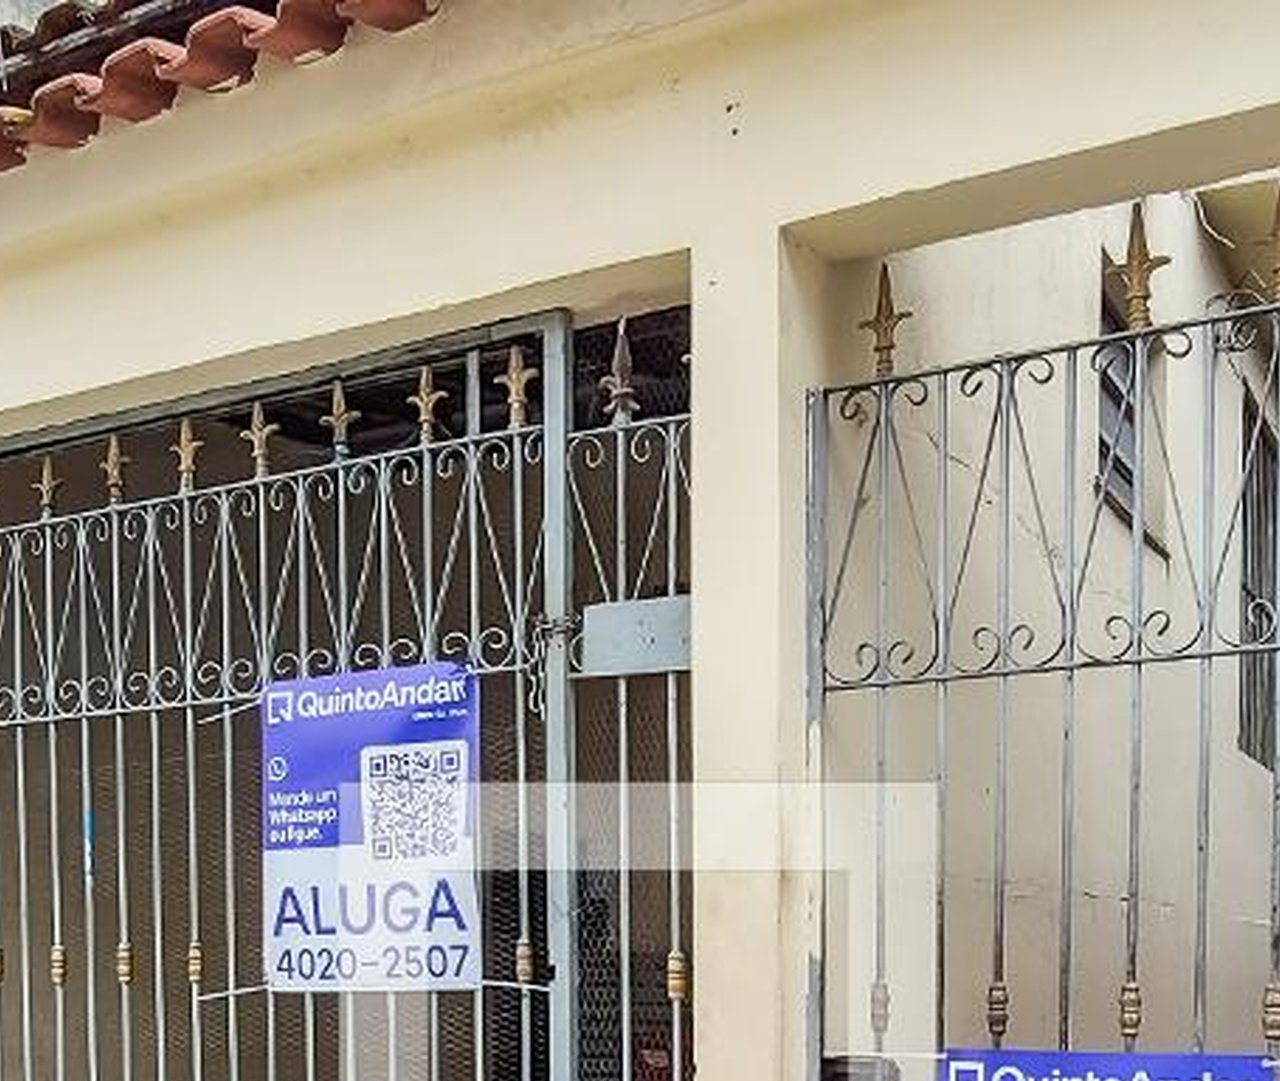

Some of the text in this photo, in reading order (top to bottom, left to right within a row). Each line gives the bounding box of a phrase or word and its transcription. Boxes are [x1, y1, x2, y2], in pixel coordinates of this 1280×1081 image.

[297, 677, 467, 717] QuintoAndar
[273, 877, 468, 937] ALUGA
[276, 944, 470, 980] 4020-2507
